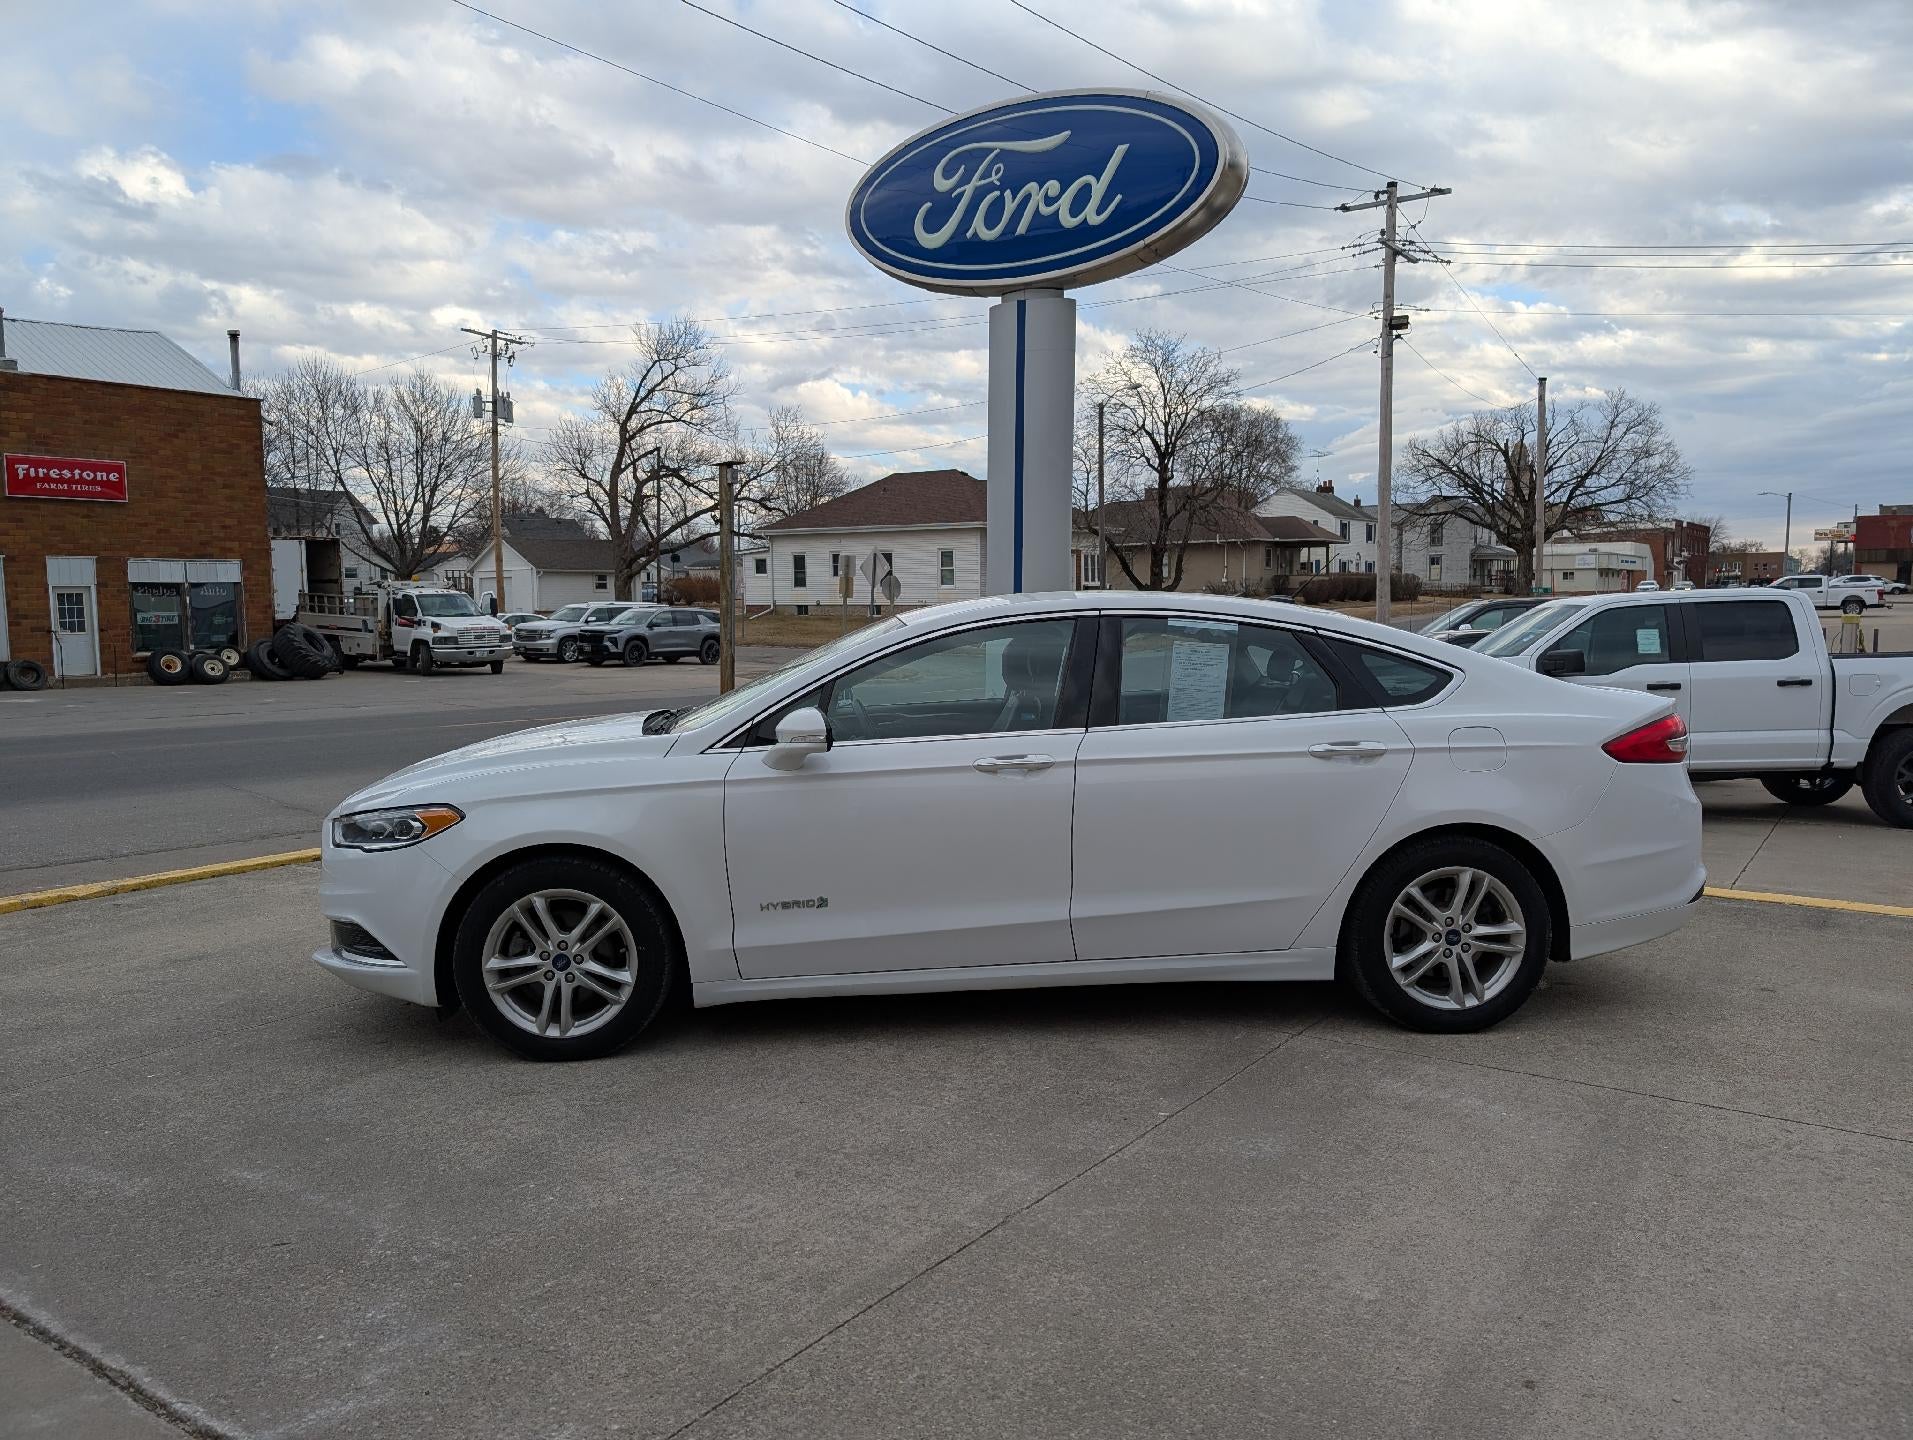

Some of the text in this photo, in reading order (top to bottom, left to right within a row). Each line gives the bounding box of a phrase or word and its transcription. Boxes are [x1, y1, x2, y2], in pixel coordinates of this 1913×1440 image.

[914, 130, 1130, 249] Ford
[15, 464, 119, 482] Firestone
[36, 482, 101, 492] FARM TIRES
[200, 585, 227, 596] Auto
[760, 899, 816, 911] HYBRID
